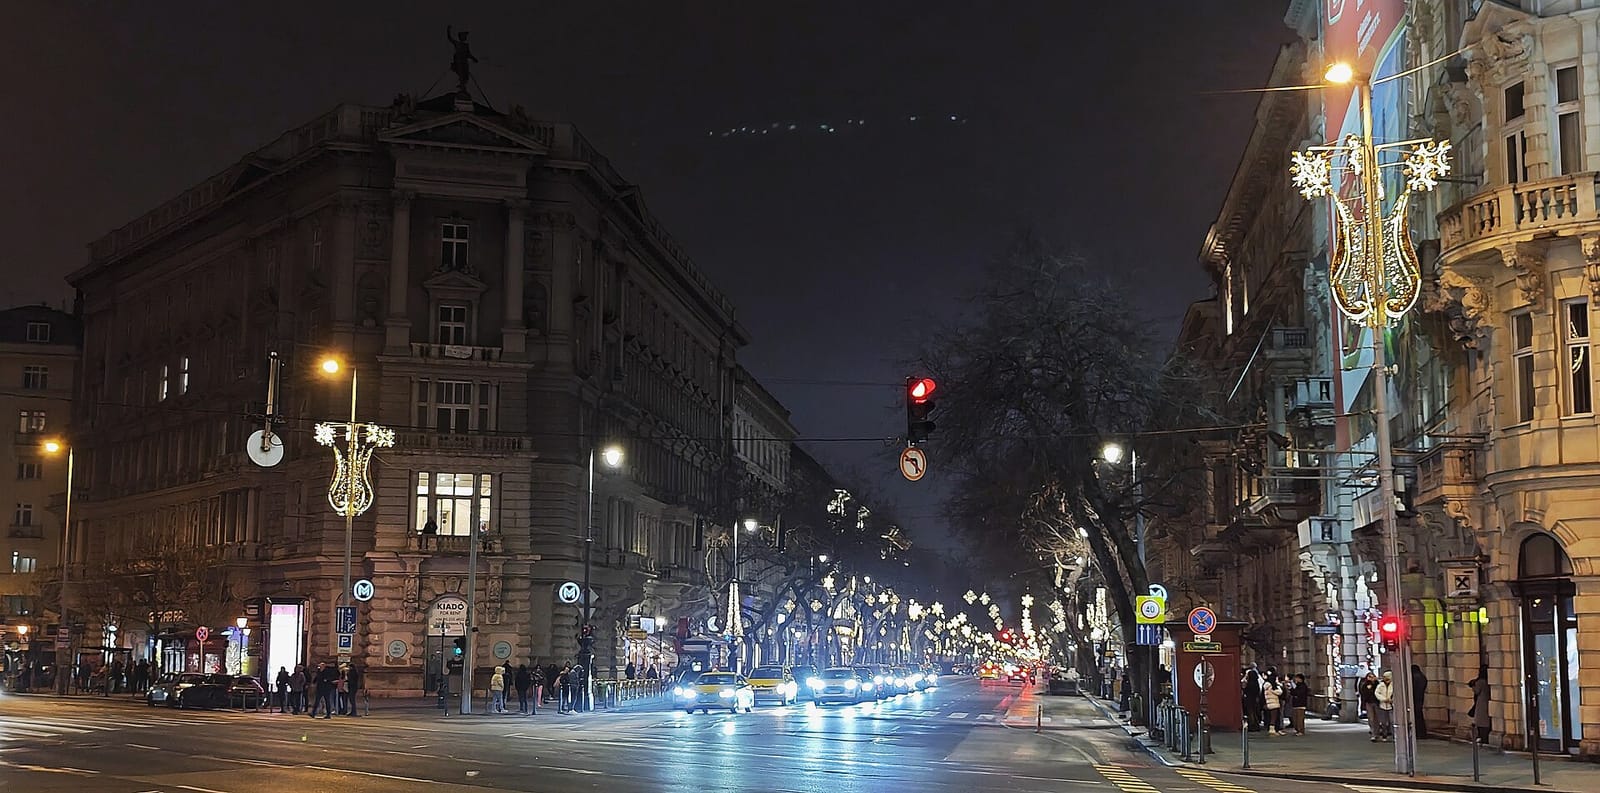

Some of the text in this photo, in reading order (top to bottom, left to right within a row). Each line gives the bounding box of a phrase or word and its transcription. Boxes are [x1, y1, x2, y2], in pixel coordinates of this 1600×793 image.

[437, 602, 465, 610] KIADÓ
[1145, 606, 1155, 614] 40
[341, 637, 349, 646] P
